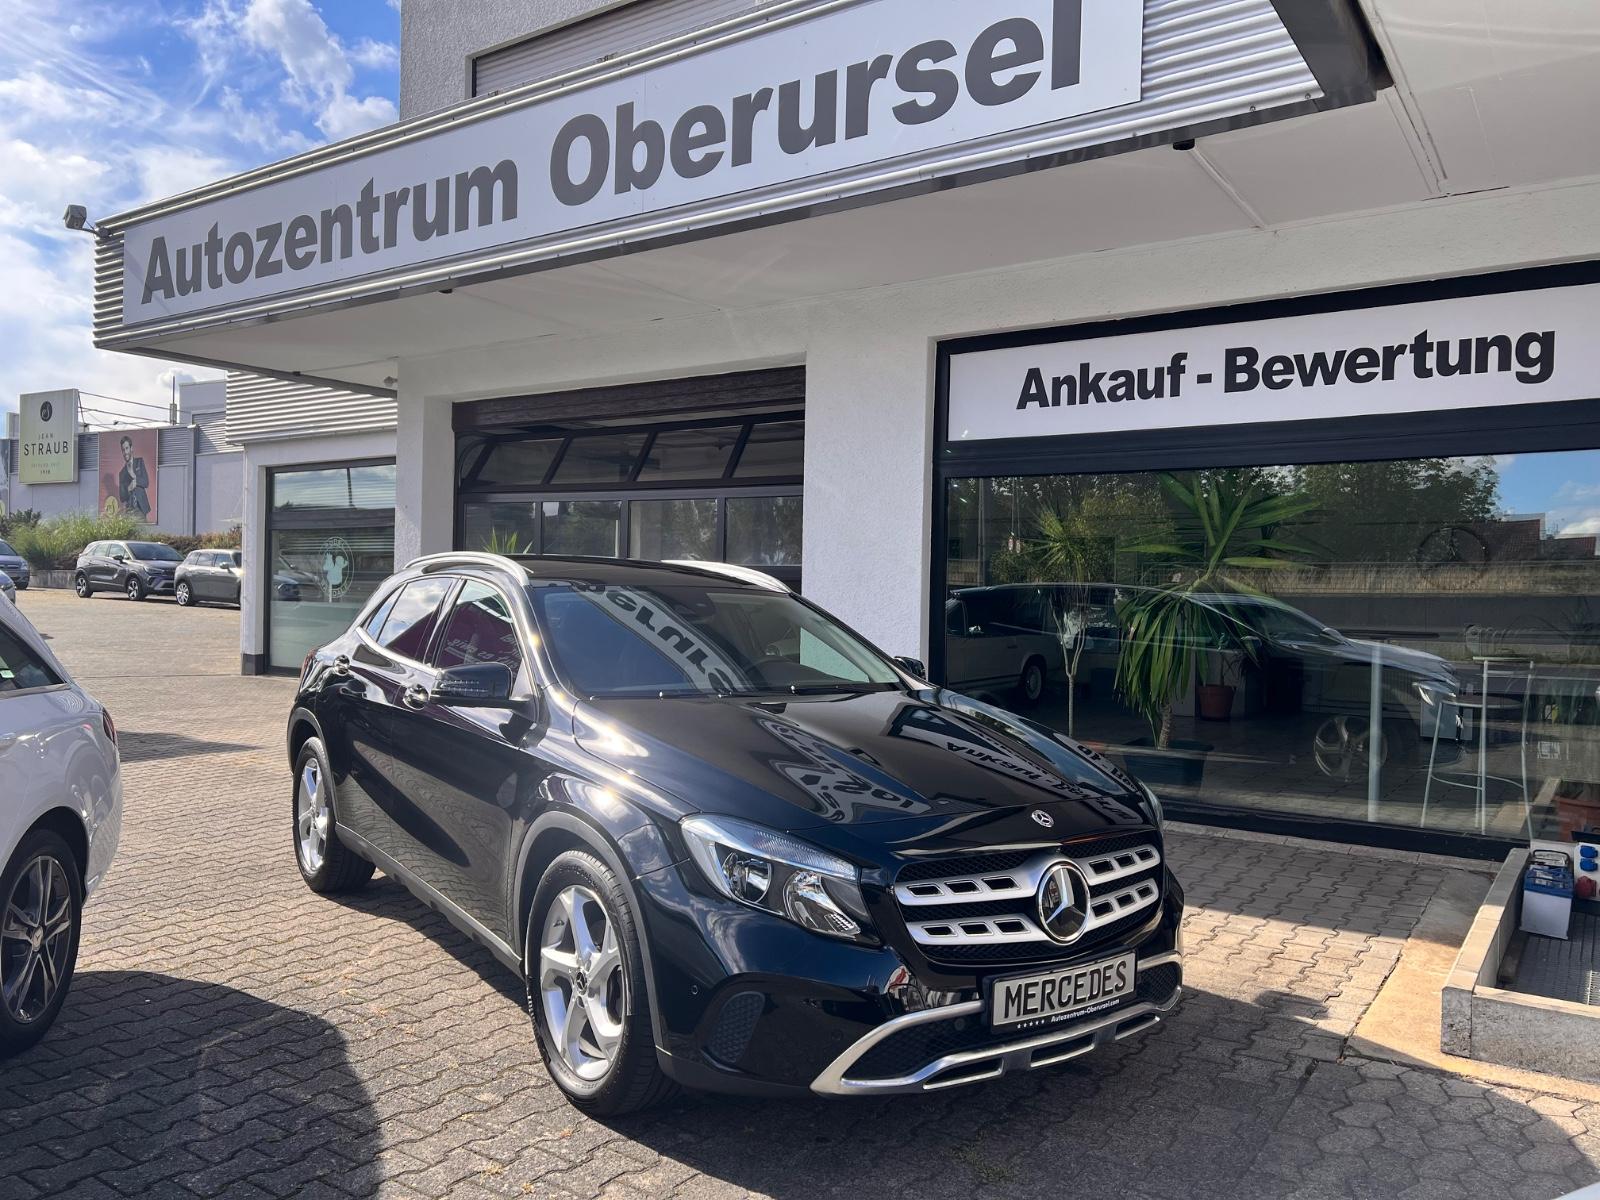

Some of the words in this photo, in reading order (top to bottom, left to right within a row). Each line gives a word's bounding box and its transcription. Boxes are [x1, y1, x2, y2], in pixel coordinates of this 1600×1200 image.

[141, 158, 518, 305] Autozentrum
[549, 0, 1081, 206] Oberursel
[1016, 352, 1187, 410] Ankauf
[1197, 374, 1212, 384] -
[1224, 329, 1556, 384] Bewertung
[24, 441, 69, 456] STRAUB
[1004, 960, 1127, 1018] MERCEDES
